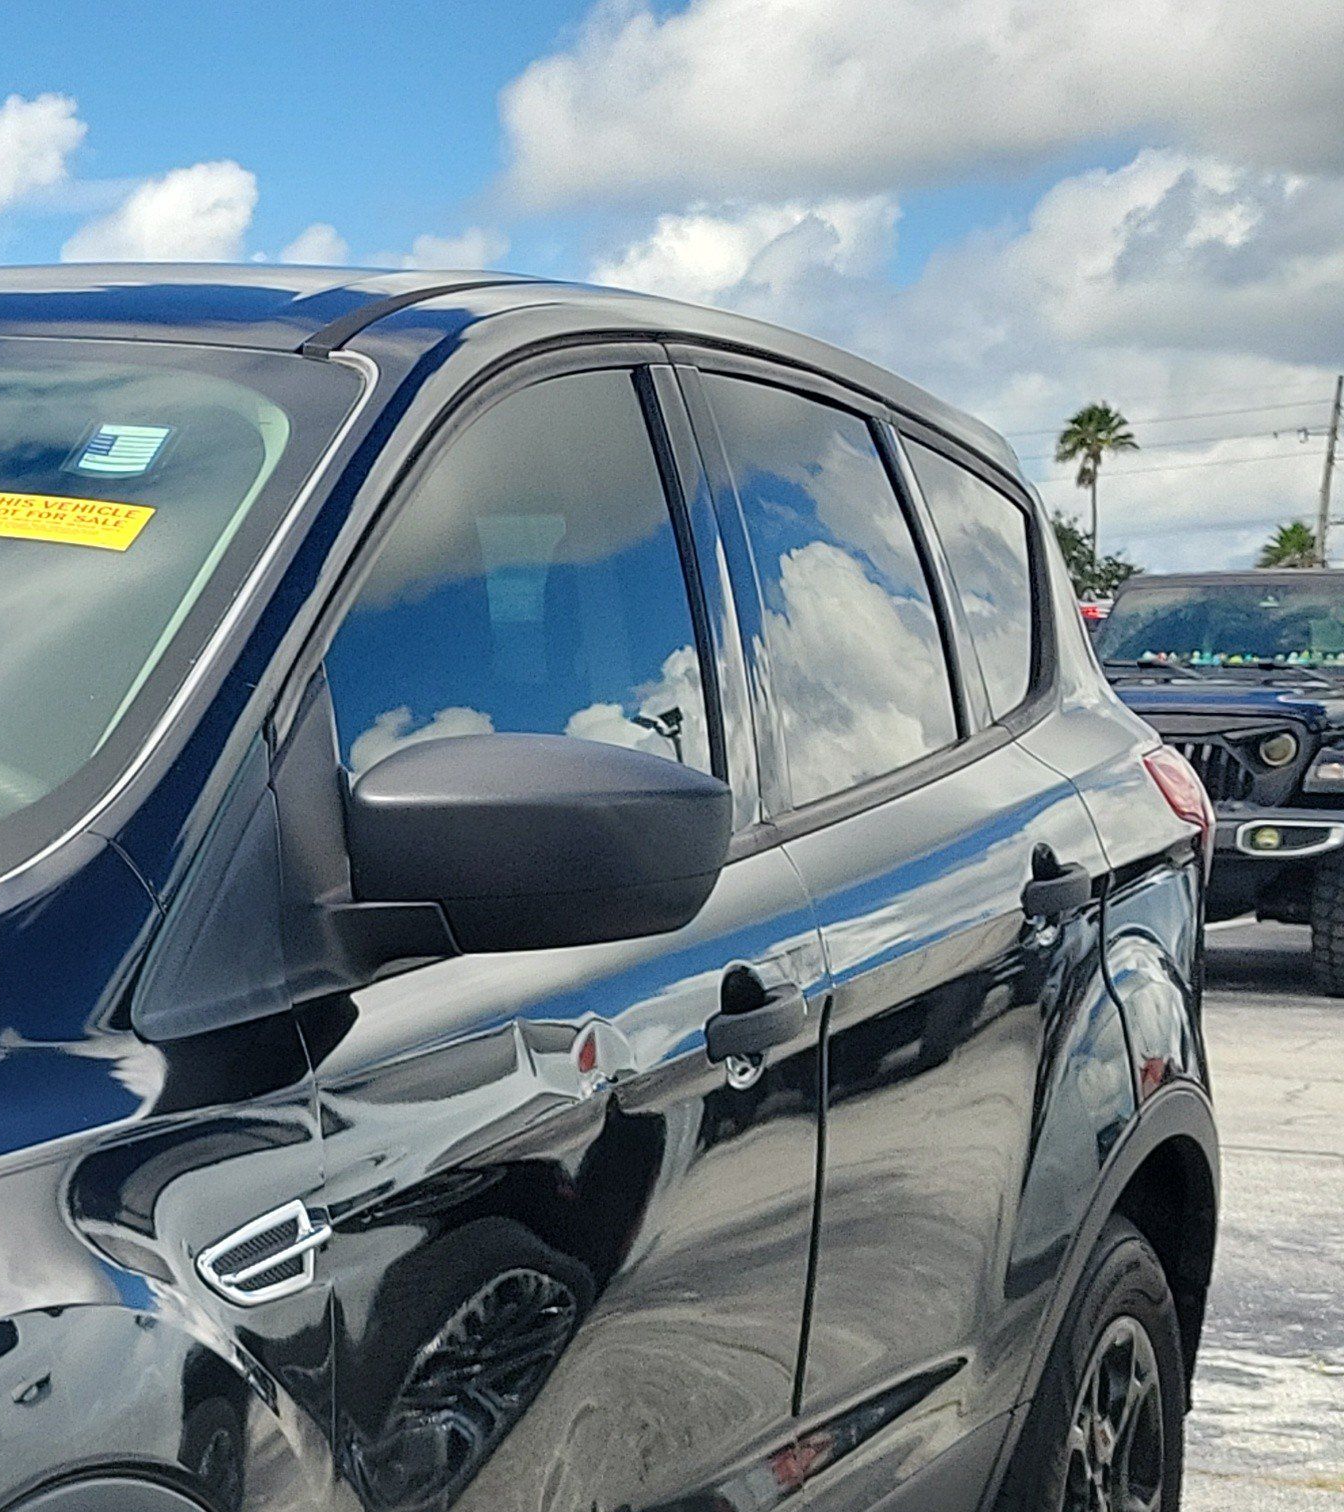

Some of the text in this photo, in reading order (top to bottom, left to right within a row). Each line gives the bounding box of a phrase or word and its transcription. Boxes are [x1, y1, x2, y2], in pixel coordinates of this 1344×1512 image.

[44, 500, 141, 519] VEHICLE
[26, 510, 66, 521] FOR
[75, 515, 128, 528] SALE
